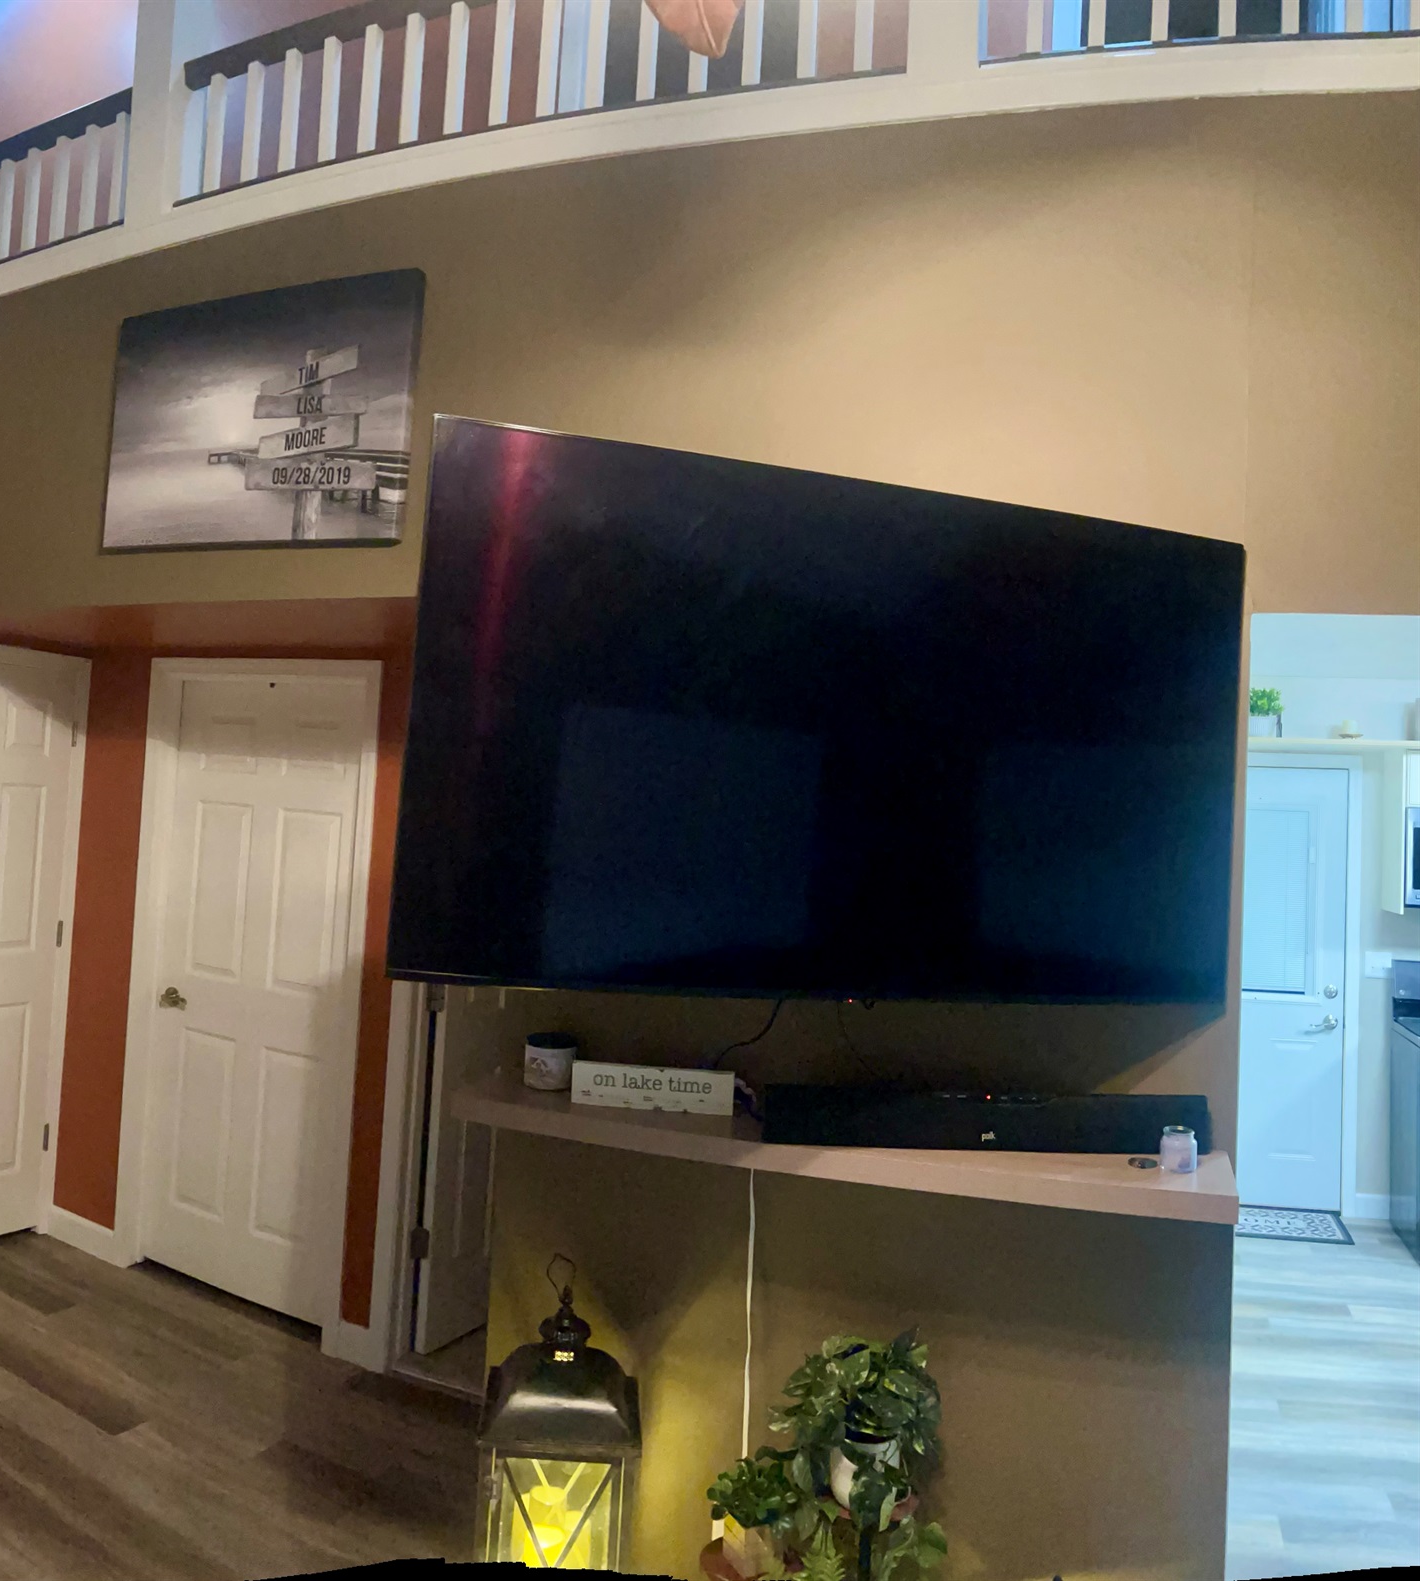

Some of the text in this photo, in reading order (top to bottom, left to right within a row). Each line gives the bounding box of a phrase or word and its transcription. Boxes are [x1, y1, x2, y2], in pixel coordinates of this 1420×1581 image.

[298, 361, 320, 385] TIM
[296, 395, 325, 415] LISA
[284, 427, 327, 451] MOORE
[271, 466, 351, 485] 09/28/2019
[592, 1072, 713, 1095] on lake time
